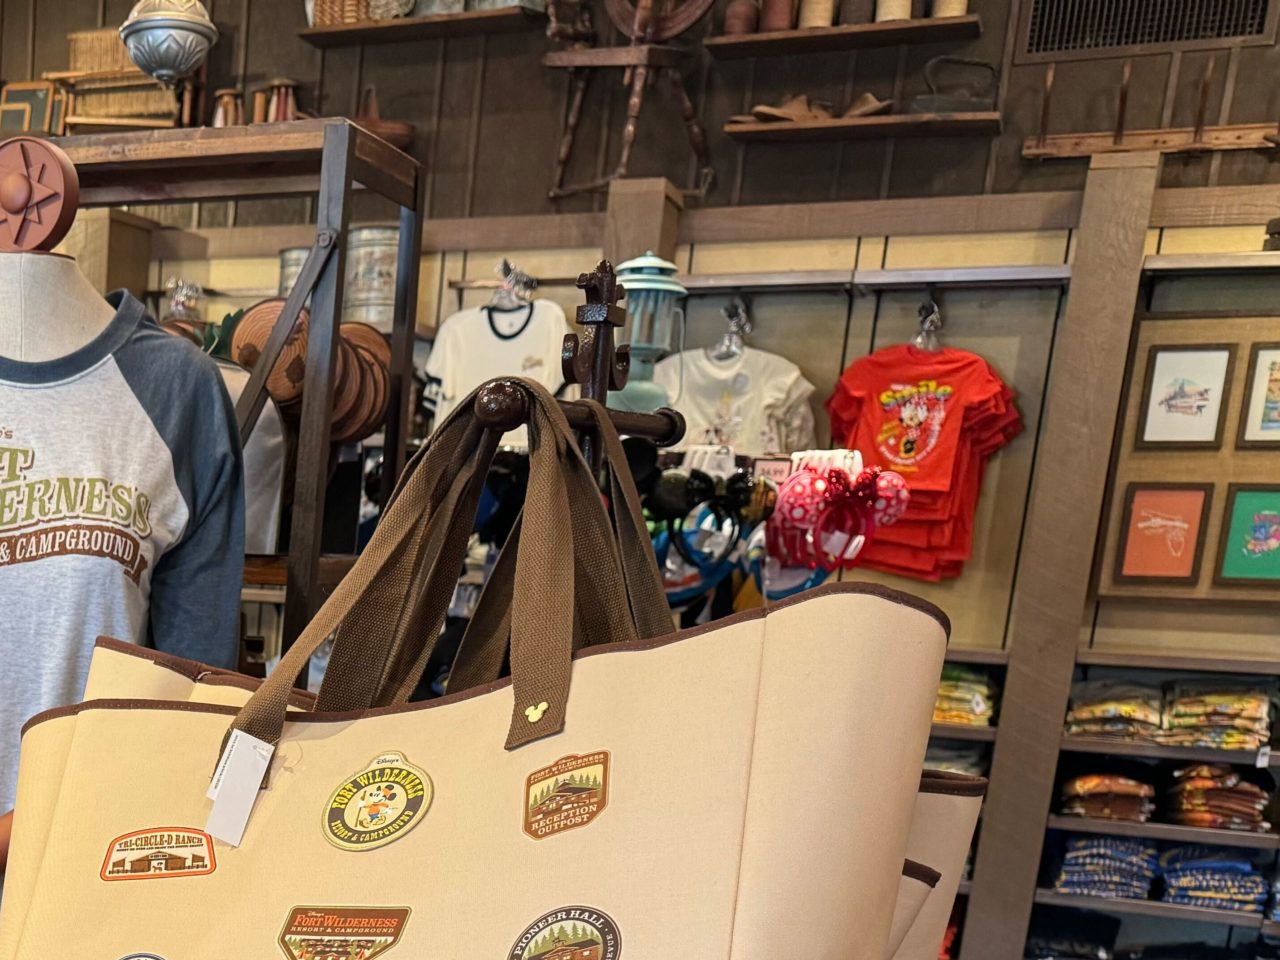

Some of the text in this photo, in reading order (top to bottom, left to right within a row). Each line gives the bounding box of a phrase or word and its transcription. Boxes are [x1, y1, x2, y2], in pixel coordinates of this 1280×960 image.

[15, 528, 134, 561] CAMPGROUND
[332, 769, 424, 809] FORT WILDERNESS
[360, 810, 413, 841] CAMPGROUND
[531, 804, 597, 831] RECEPTION
[538, 814, 590, 835] OUTPOST
[175, 834, 203, 845] RANCH
[293, 915, 398, 928] FORT WILDERNESS
[514, 910, 605, 955] PIONEER HALL
